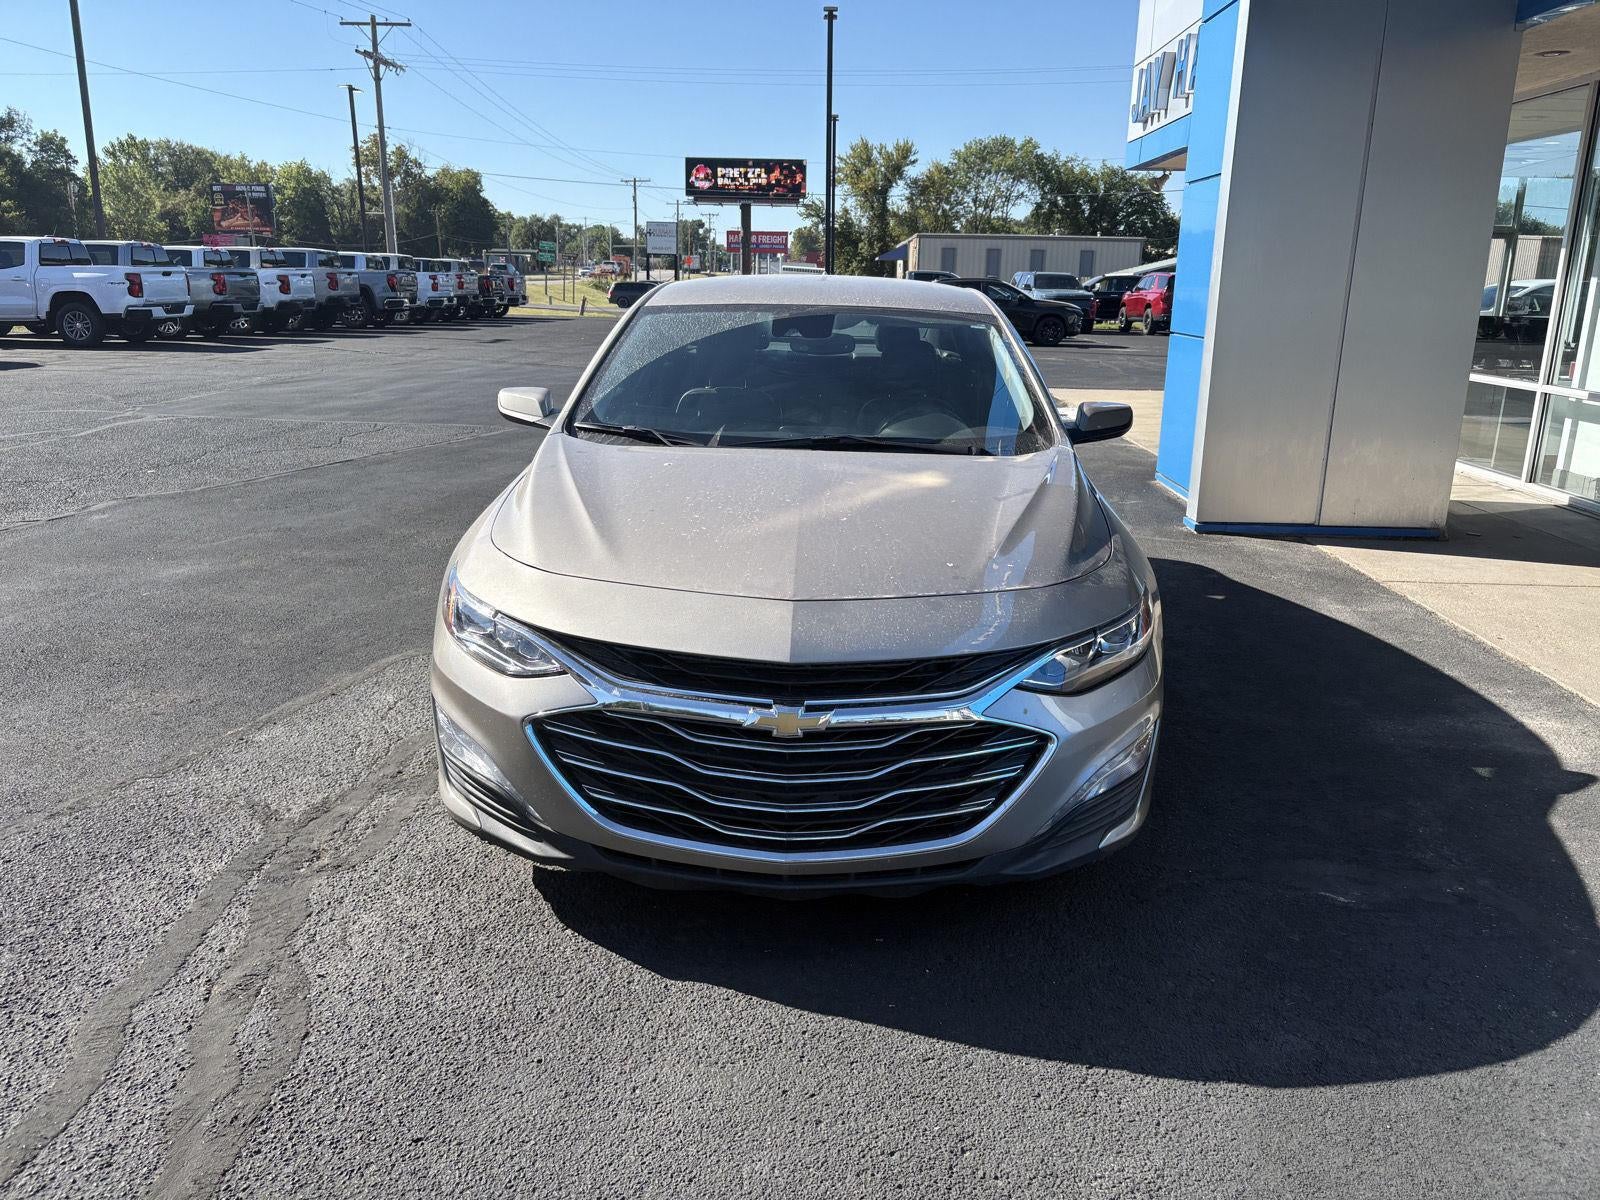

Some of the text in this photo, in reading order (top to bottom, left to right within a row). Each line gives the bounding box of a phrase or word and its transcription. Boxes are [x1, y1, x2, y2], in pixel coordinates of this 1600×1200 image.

[1132, 51, 1176, 123] JAY
[728, 234, 787, 244] HAR FREIGHT
